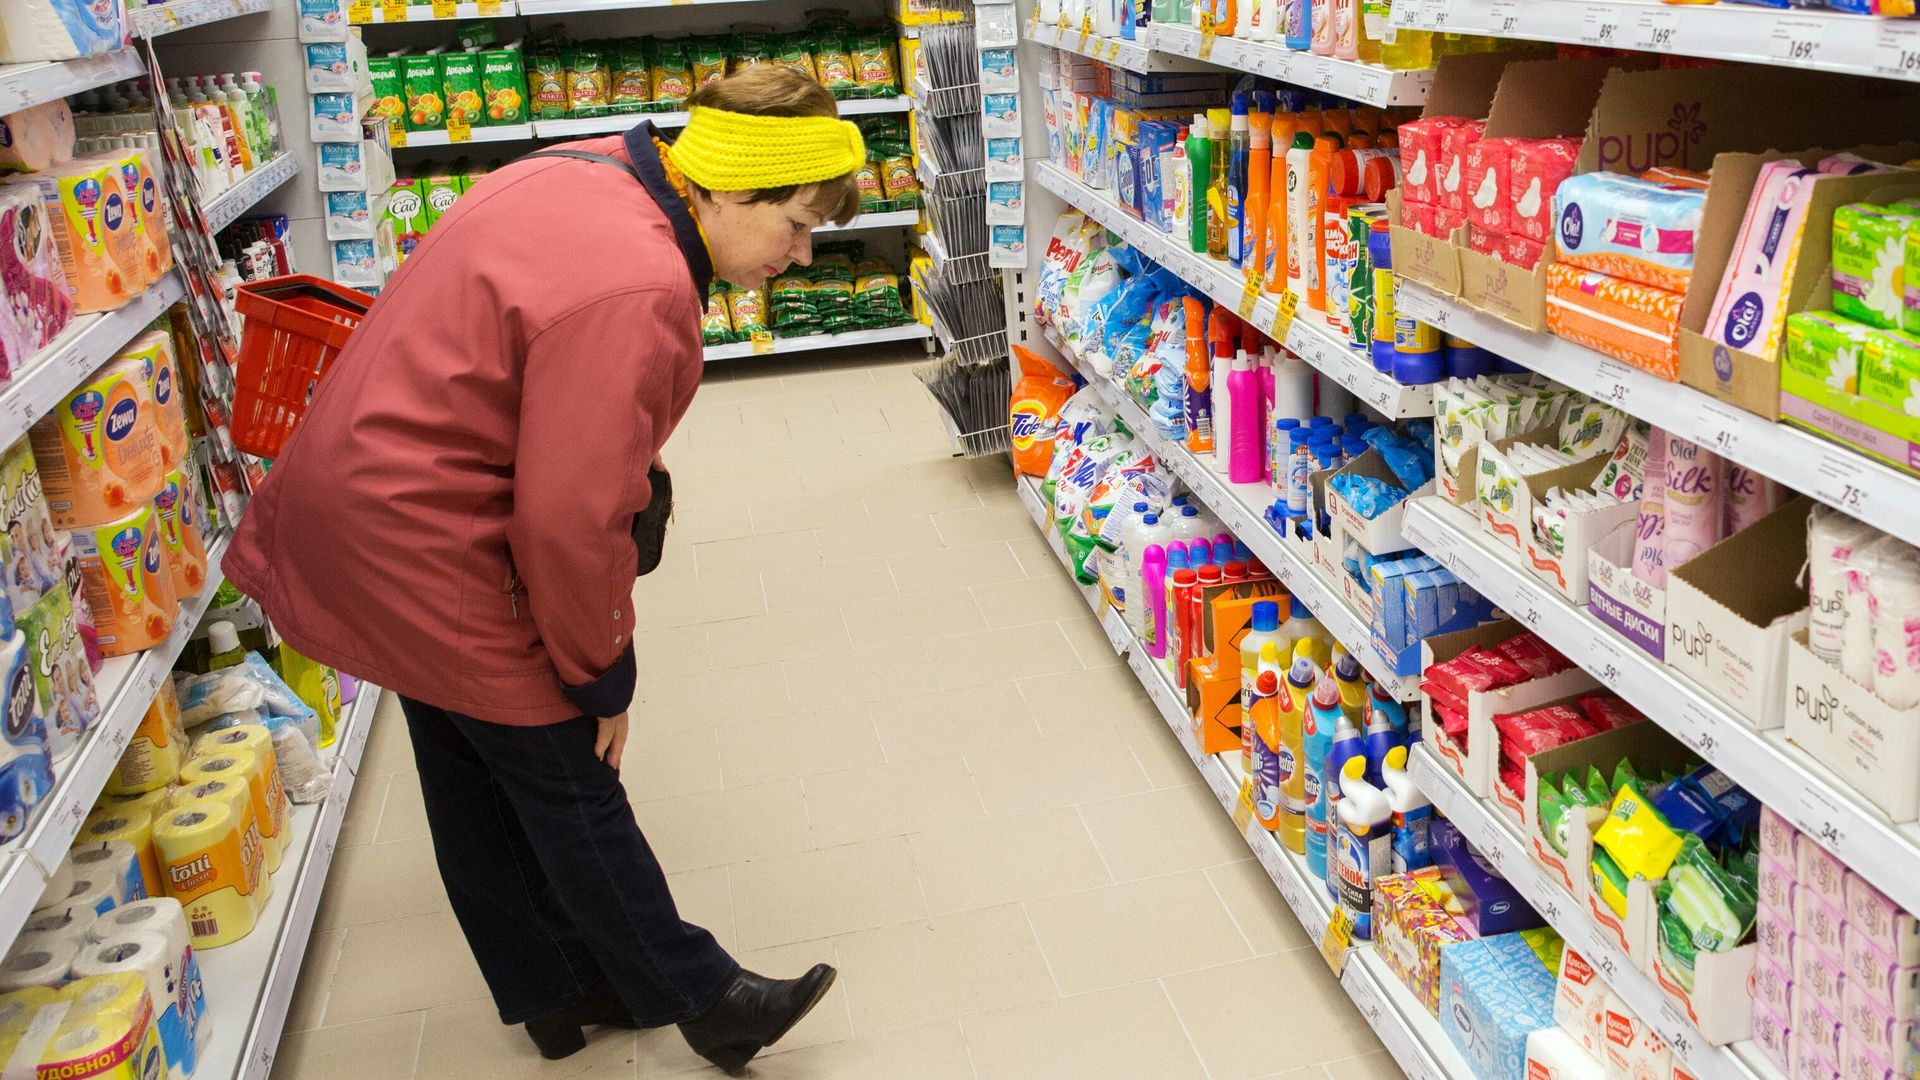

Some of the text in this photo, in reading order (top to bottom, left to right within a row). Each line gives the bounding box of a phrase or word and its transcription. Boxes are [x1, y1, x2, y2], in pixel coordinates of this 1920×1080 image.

[407, 67, 435, 79] Добрый
[446, 64, 474, 76] Добрый
[485, 62, 513, 74] Добрый
[1599, 130, 1691, 178] pupi
[1563, 216, 1580, 237] Ola!
[1731, 300, 1758, 342] Ola!
[110, 409, 136, 434] Zewa
[1012, 413, 1041, 436] Tide
[1670, 438, 1698, 461] Ola!
[1665, 460, 1712, 494] Silk
[1590, 587, 1660, 643] ВАТНЫЕ ДИСКИ
[1671, 622, 1709, 667] pupi
[1795, 684, 1834, 734] pupi
[1492, 903, 1509, 913] Zewa
[37, 1051, 116, 1080] УДОБНО!
